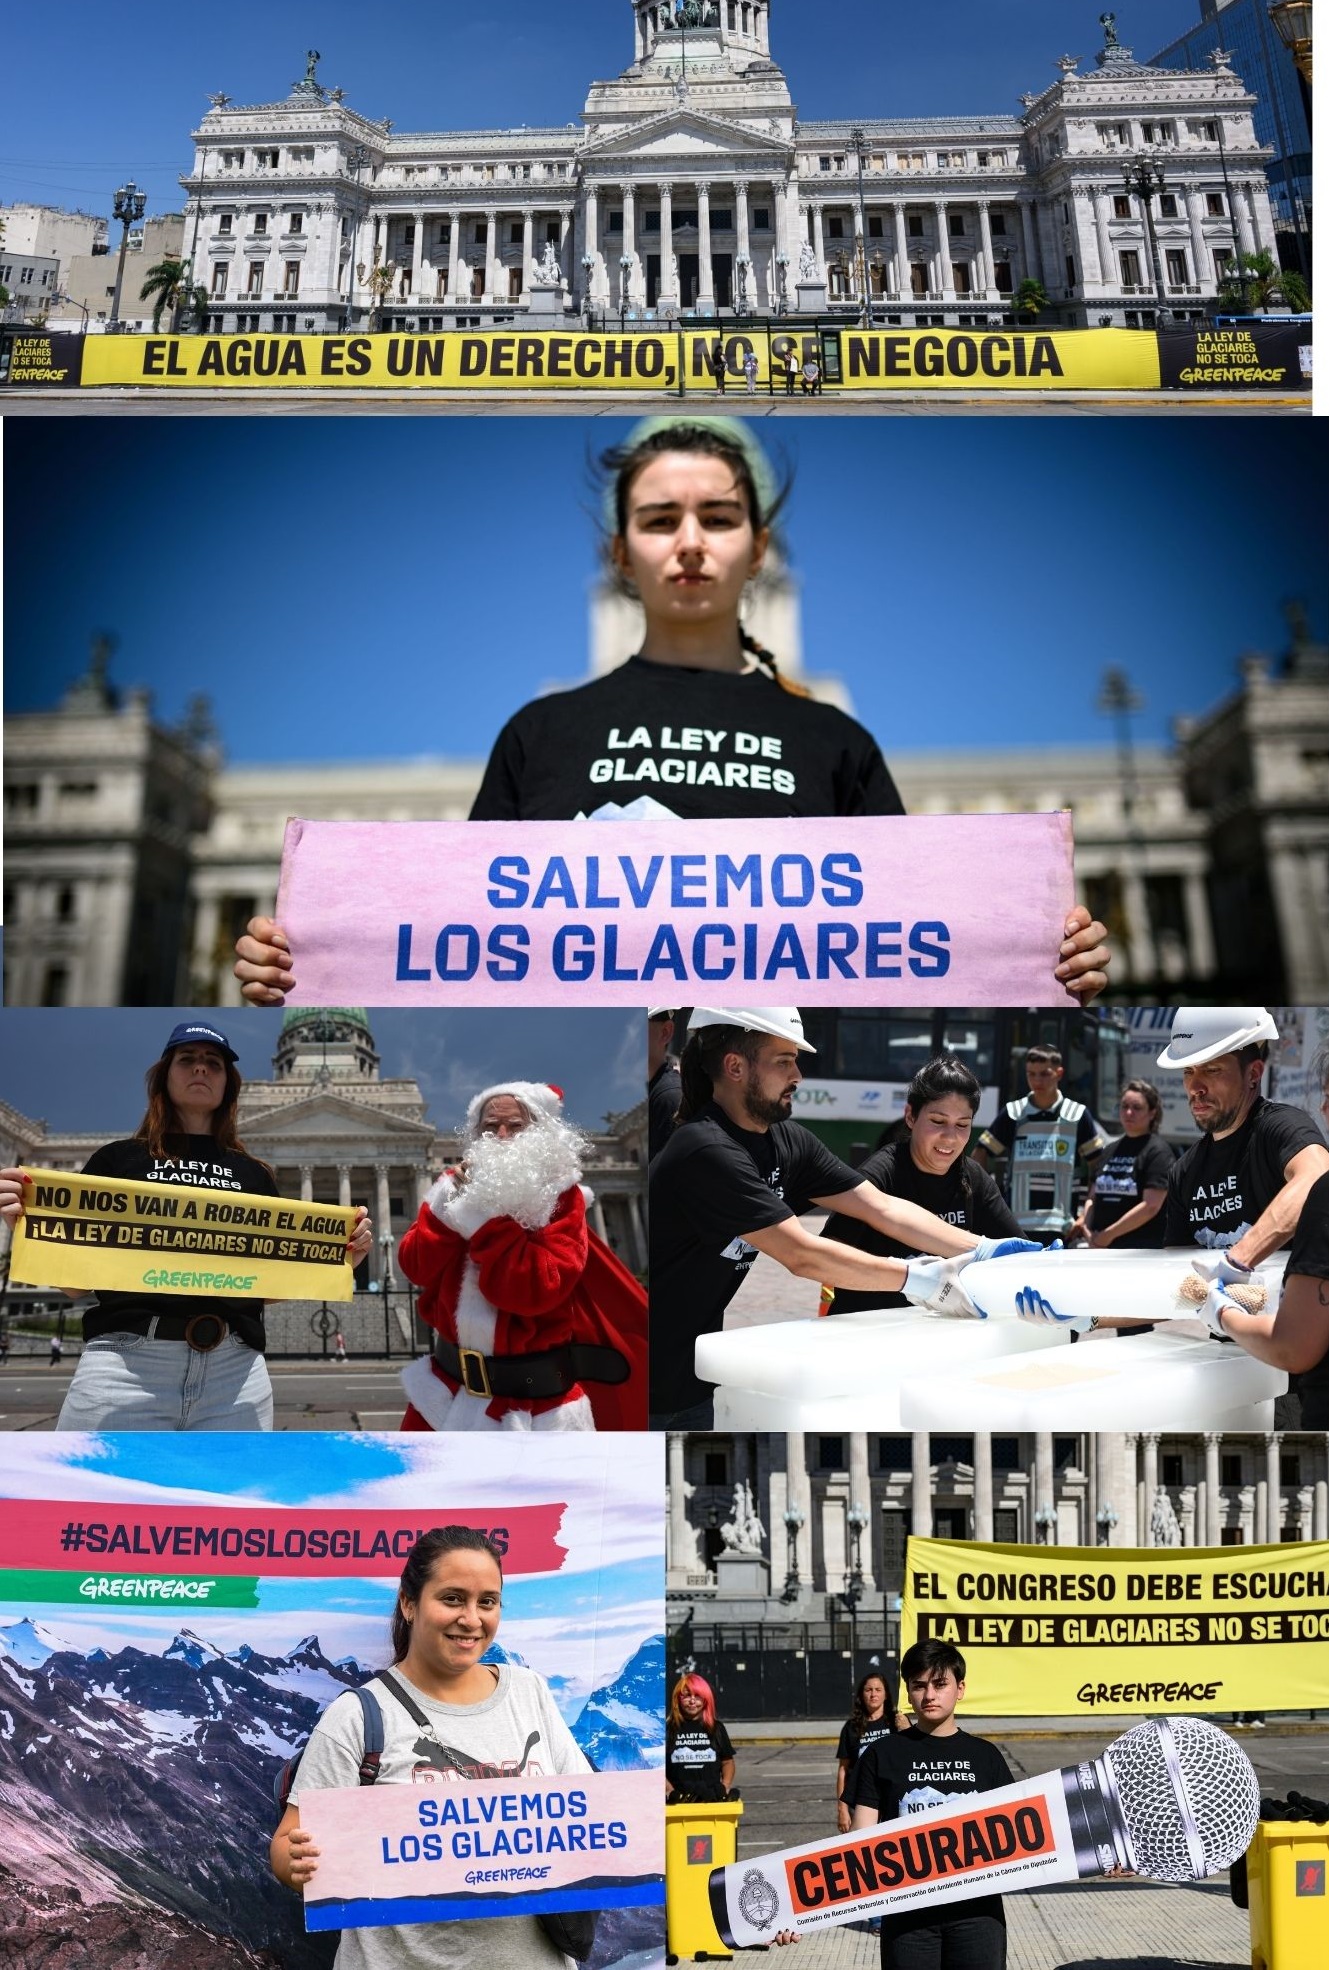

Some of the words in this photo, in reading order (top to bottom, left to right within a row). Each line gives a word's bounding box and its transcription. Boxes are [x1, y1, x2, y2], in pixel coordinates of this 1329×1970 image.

[23, 339, 38, 347] LEY
[40, 339, 51, 347] DE
[1196, 343, 1256, 353] GLACIARES
[1197, 332, 1212, 342] LA
[1214, 332, 1233, 342] LEY
[1237, 332, 1252, 342] DE
[14, 348, 52, 356] LACIARES
[20, 357, 31, 365] SE
[32, 357, 52, 365] TOCA
[142, 339, 187, 376] EL
[197, 339, 307, 377] AGUA
[321, 338, 372, 377] ES
[386, 338, 446, 377] UN
[459, 338, 676, 386] DERECHO,
[692, 336, 755, 378] NO
[848, 336, 1064, 377] NEGOCIA
[1196, 354, 1212, 364] NO
[1214, 354, 1228, 363] SE
[1230, 354, 1259, 364] TOCA
[1180, 367, 1286, 383] GREENPEACE
[607, 726, 652, 749] LA
[660, 727, 728, 752] LEY
[735, 732, 782, 760] DE
[589, 758, 796, 795] GLACIARES
[487, 853, 864, 909] SALVEMOS
[396, 923, 531, 982] LOS
[552, 921, 952, 981] GLACIARES
[154, 1160, 175, 1170] LA
[180, 1160, 209, 1172] LEY
[212, 1164, 233, 1178] DE
[146, 1171, 242, 1190] GLACIARES
[1192, 1186, 1207, 1200] A
[35, 1186, 71, 1208] NO
[78, 1190, 128, 1213] NOS
[135, 1195, 178, 1217] VAN
[182, 1200, 198, 1220] A
[204, 1203, 272, 1227] ROBAR
[276, 1212, 297, 1231] EL
[301, 1215, 347, 1237] AGUA
[947, 1211, 966, 1225] DE
[32, 1220, 67, 1240] ¡LA
[73, 1222, 113, 1243] LEY
[117, 1226, 144, 1245] DE
[150, 1228, 247, 1253] GLACIARES
[251, 1238, 275, 1255] NO
[278, 1240, 299, 1257] SE
[302, 1243, 346, 1261] TOCA!
[143, 1269, 258, 1290] GREENPEACE
[60, 1522, 510, 1560] #SALVEMOSLOSGLACS
[79, 1577, 216, 1599] GREENPEACE
[913, 1572, 948, 1600] EL
[956, 1573, 1117, 1601] CONGRESO
[1126, 1574, 1202, 1601] DEBE
[1212, 1571, 1329, 1600] ESCUCH
[928, 1618, 961, 1643] LA
[967, 1618, 1014, 1643] LEY
[1021, 1619, 1055, 1643] DE
[1062, 1617, 1201, 1644] GLACIARES
[1208, 1617, 1243, 1641] NO
[1250, 1616, 1283, 1640] SE
[1077, 1682, 1223, 1706] GREENPEACE
[912, 1761, 928, 1770] LA
[930, 1761, 952, 1770] LEY
[955, 1761, 971, 1770] DE
[1079, 1762, 1096, 1790] URE
[908, 1772, 976, 1782] GLACIARES
[418, 1791, 587, 1827] SALVEMOS
[382, 1833, 443, 1864] LOS
[452, 1821, 628, 1859] GLACIARES
[793, 1806, 1046, 1907] CENSURADO
[1097, 1843, 1115, 1875] SHU
[465, 1866, 552, 1885] GREENPEACE
[927, 1886, 937, 1894] del
